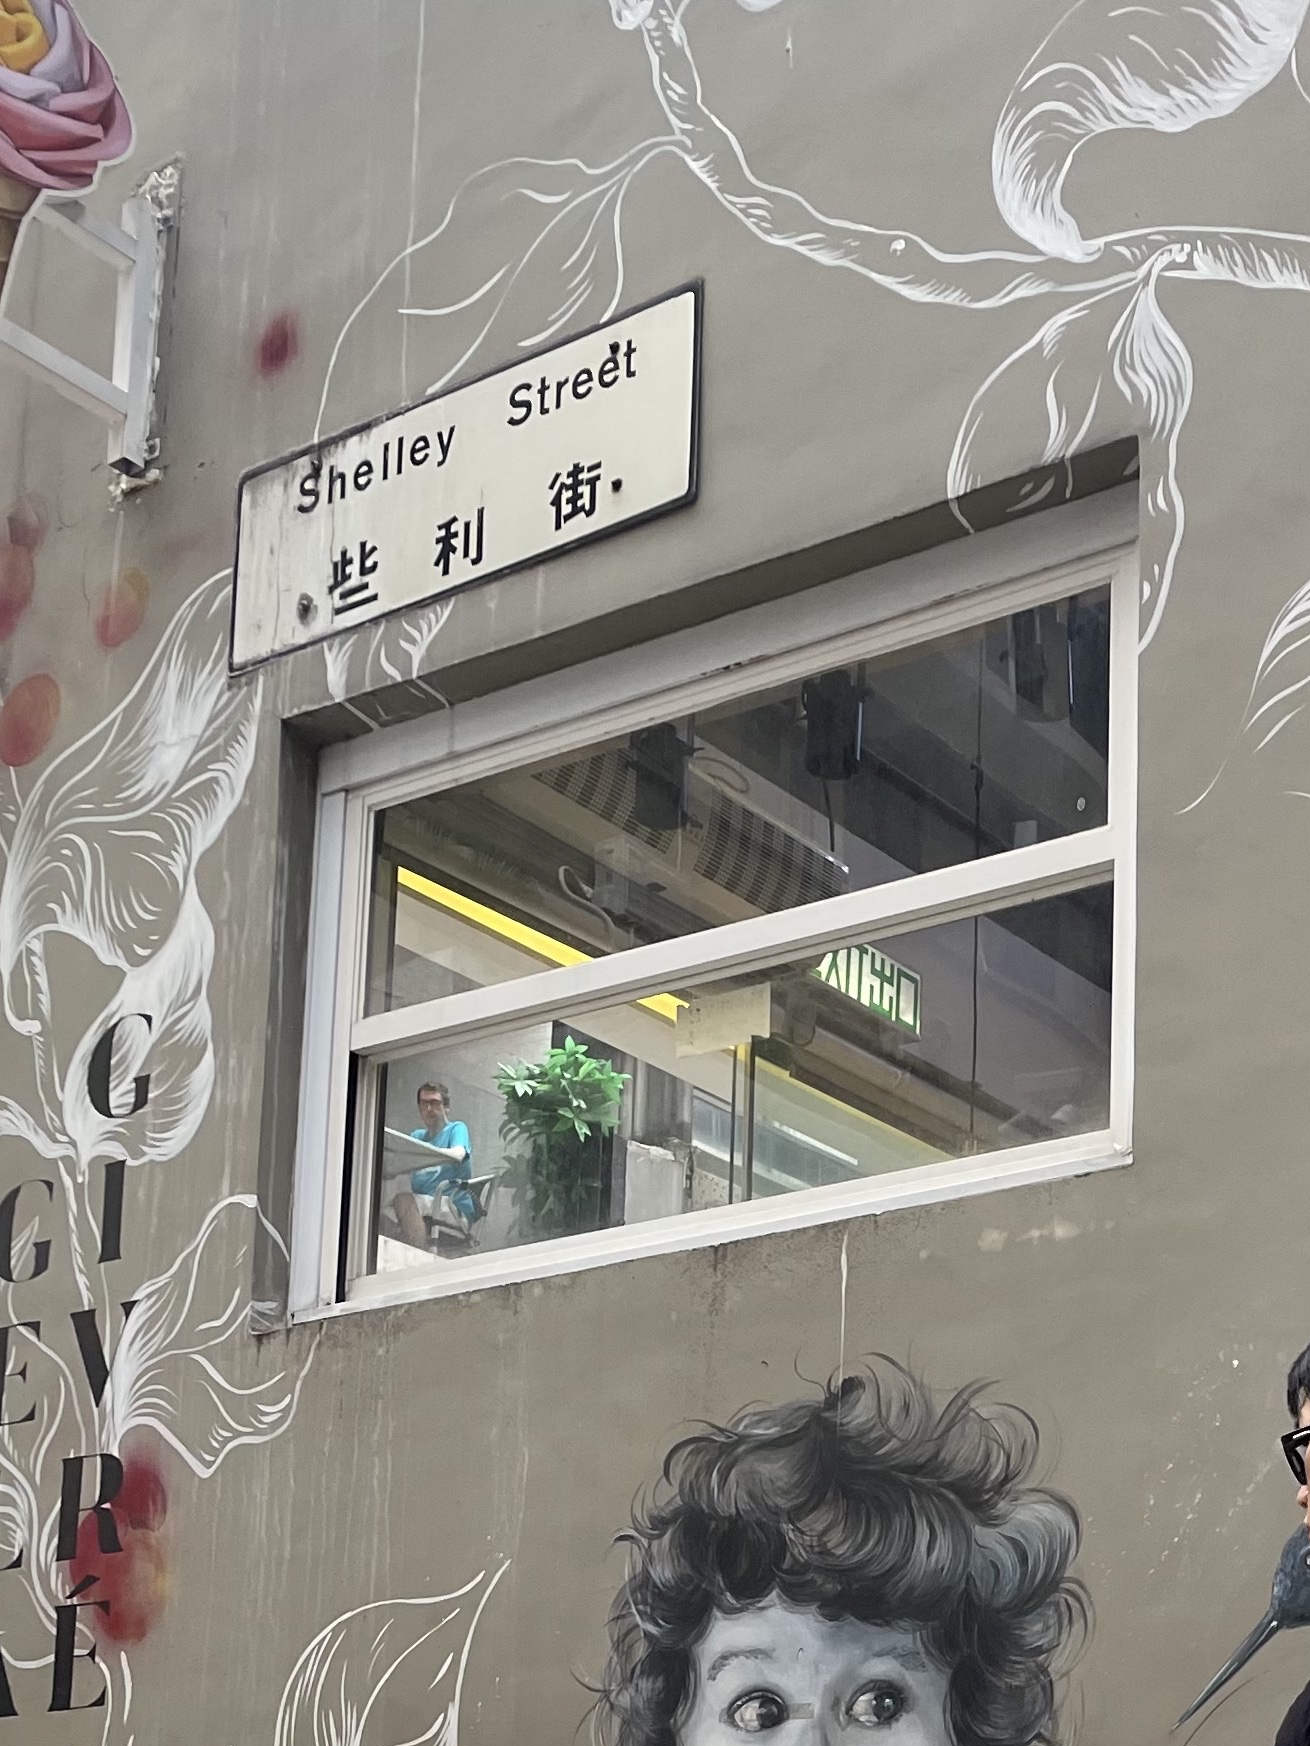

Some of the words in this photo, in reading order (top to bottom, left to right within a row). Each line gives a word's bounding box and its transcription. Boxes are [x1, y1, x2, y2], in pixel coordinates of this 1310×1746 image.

[297, 425, 456, 514] Shelley
[507, 339, 637, 426] Street
[328, 462, 602, 615] 些利街
[870, 951, 919, 1034] 出口
